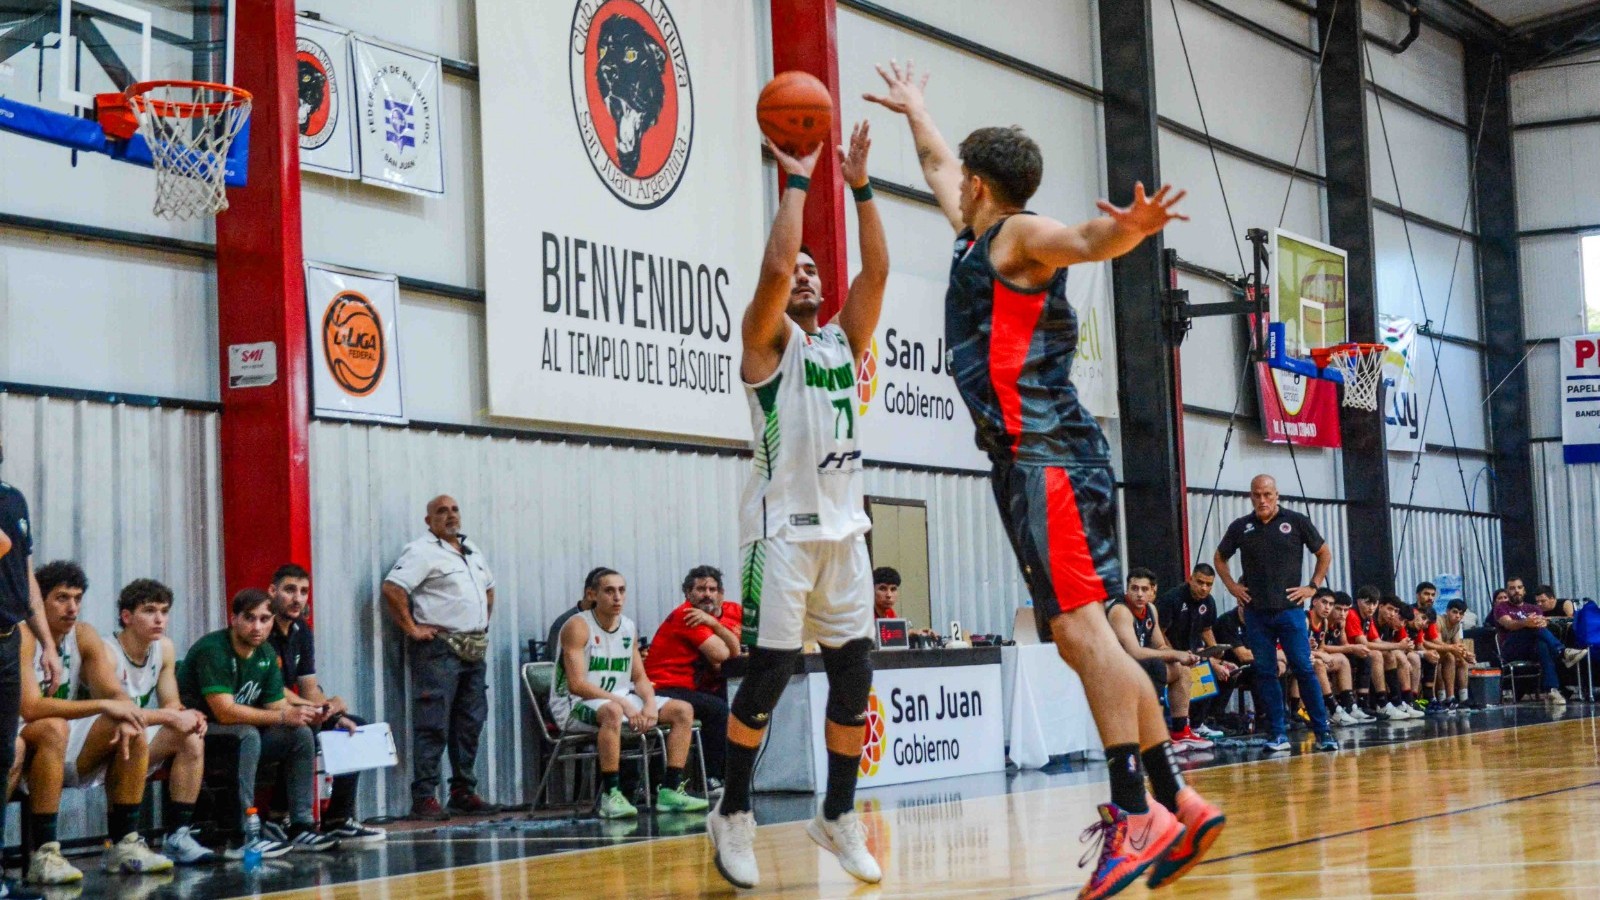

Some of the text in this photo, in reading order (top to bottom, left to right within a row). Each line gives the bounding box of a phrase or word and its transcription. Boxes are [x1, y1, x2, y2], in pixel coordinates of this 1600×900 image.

[579, 110, 688, 201] San Juan Argentina
[542, 231, 731, 342] BIENVENIDOS
[348, 349, 377, 362] FEDERAL
[541, 327, 732, 395] AL TEMPLO DEL BÁSQUET
[885, 327, 925, 373] San
[884, 382, 955, 421] Gobierno
[952, 622, 960, 641] 2
[890, 685, 982, 724] San Juan
[893, 733, 960, 766] Gobierno
